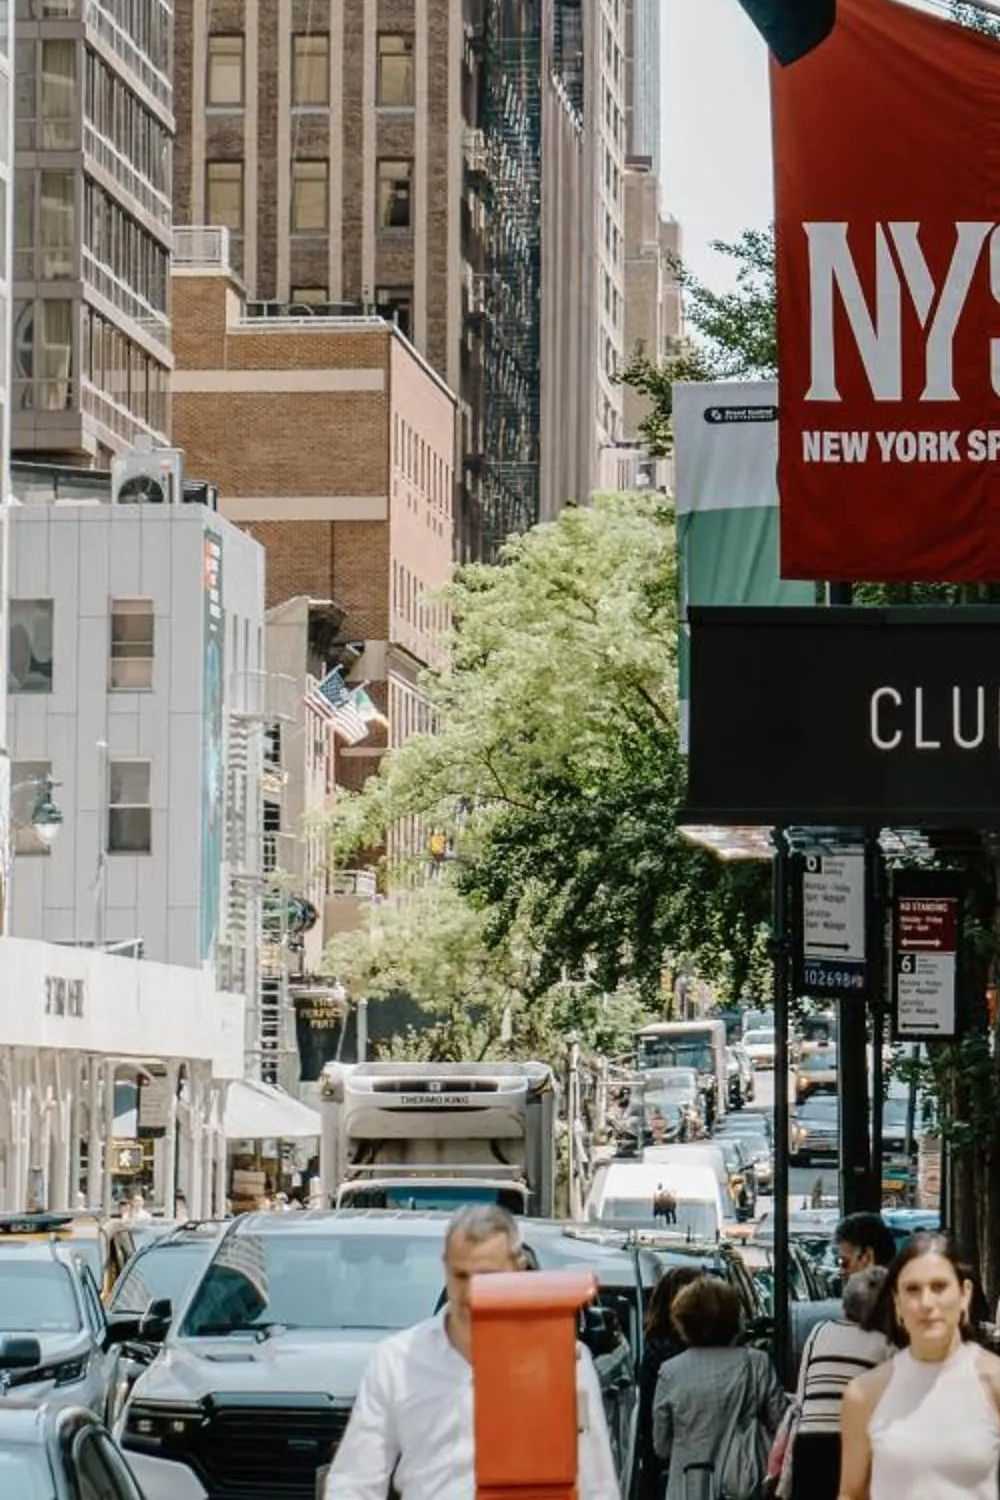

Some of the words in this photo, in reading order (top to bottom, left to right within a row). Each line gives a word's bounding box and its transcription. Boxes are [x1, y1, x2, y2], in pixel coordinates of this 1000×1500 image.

[802, 431, 868, 463] NEW
[876, 430, 961, 463] YORK
[901, 955, 912, 973] 6
